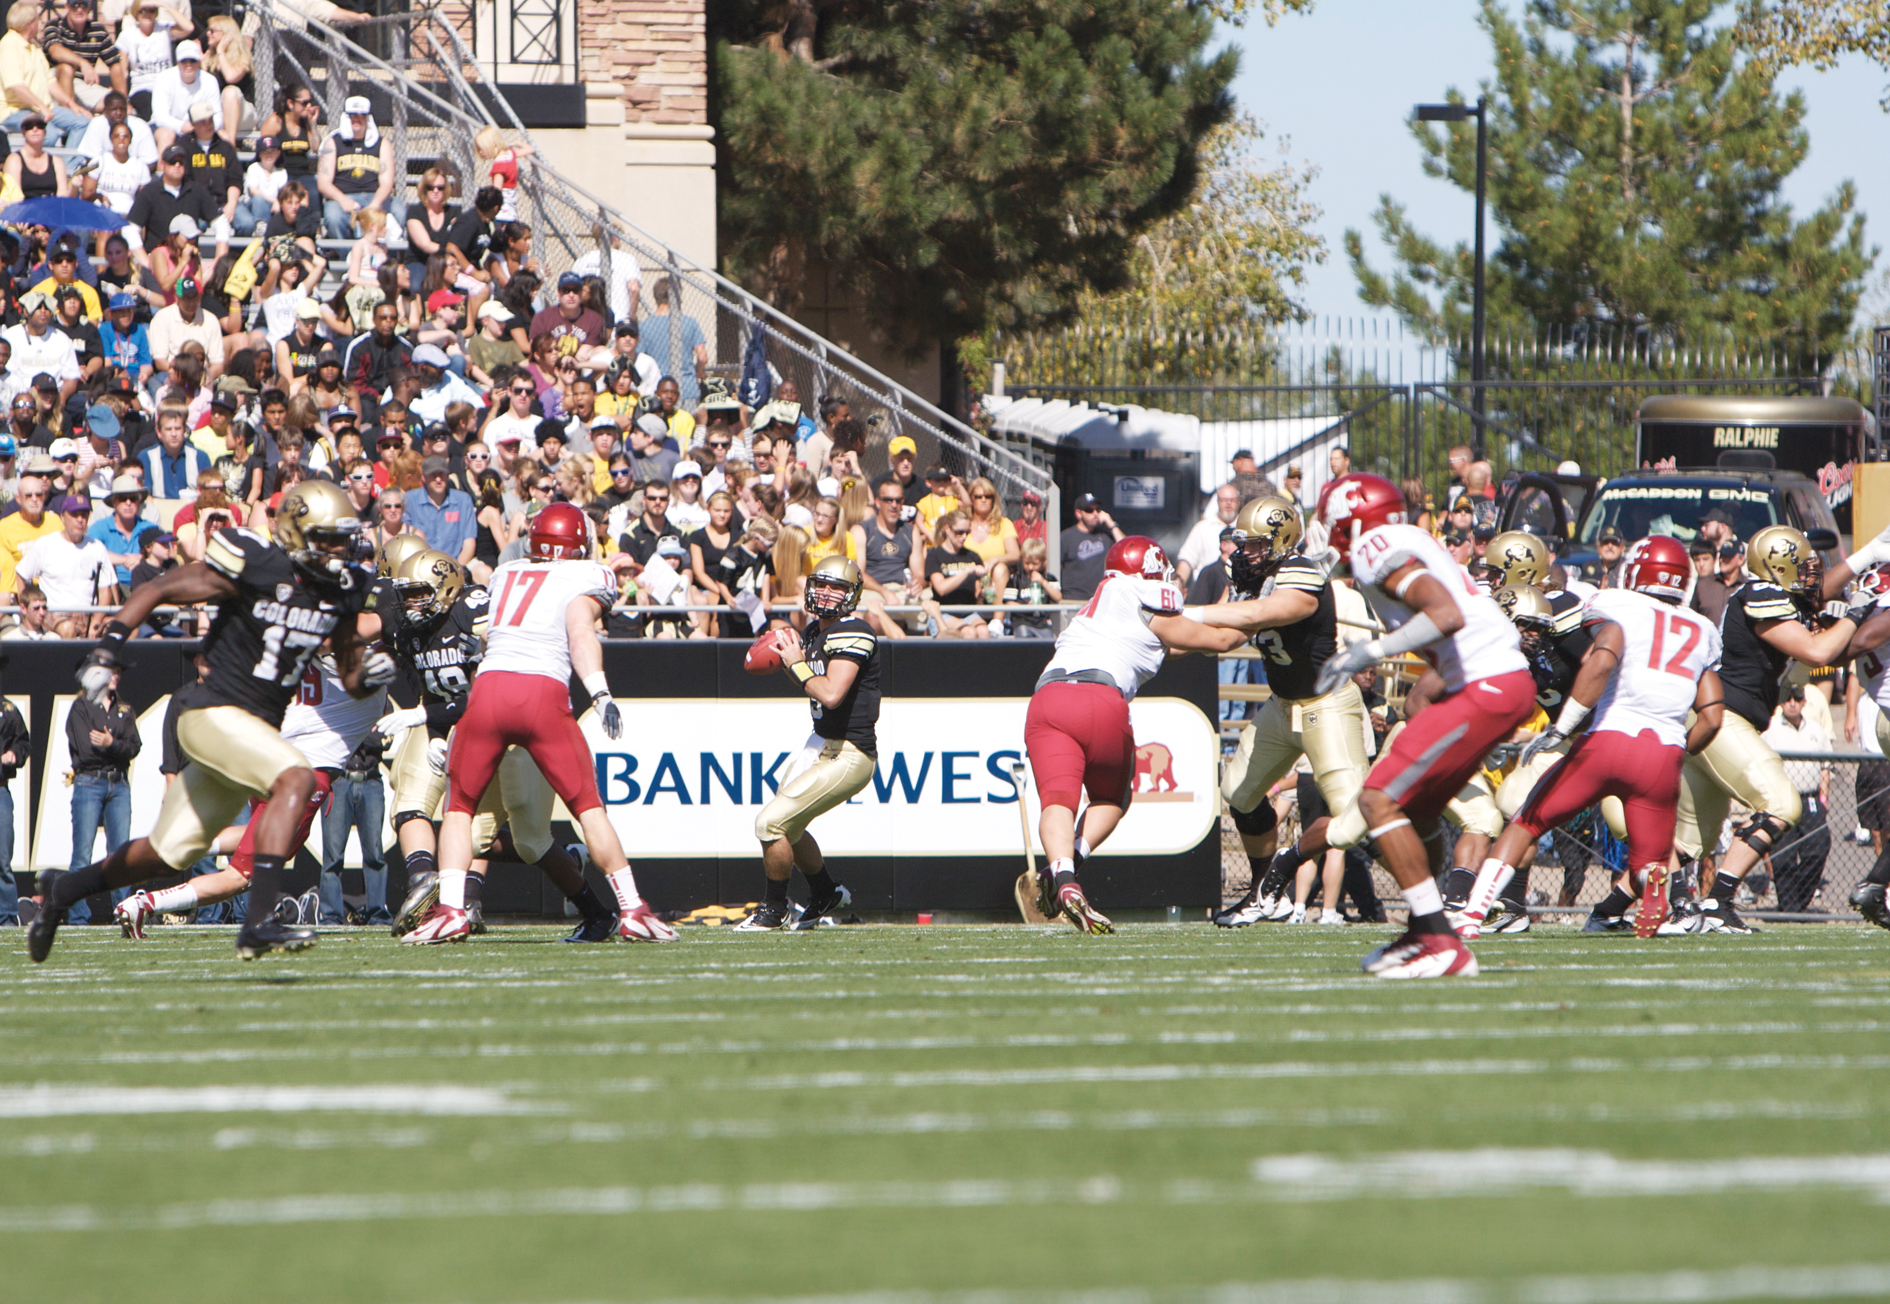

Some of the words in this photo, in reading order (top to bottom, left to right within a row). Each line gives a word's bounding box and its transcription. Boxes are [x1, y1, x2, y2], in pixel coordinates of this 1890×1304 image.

[1713, 427, 1780, 449] RALPHIE
[1601, 486, 1702, 501] McCADDON
[1708, 488, 1769, 504] GMC
[553, 545, 564, 558] 17
[1357, 534, 1389, 568] 20
[1671, 575, 1682, 587] 12
[493, 570, 550, 627] 17
[1160, 588, 1176, 611] 61
[252, 624, 322, 687] 17
[1647, 608, 1702, 681] 12
[595, 752, 791, 805] BANK
[872, 750, 1032, 804] WES
